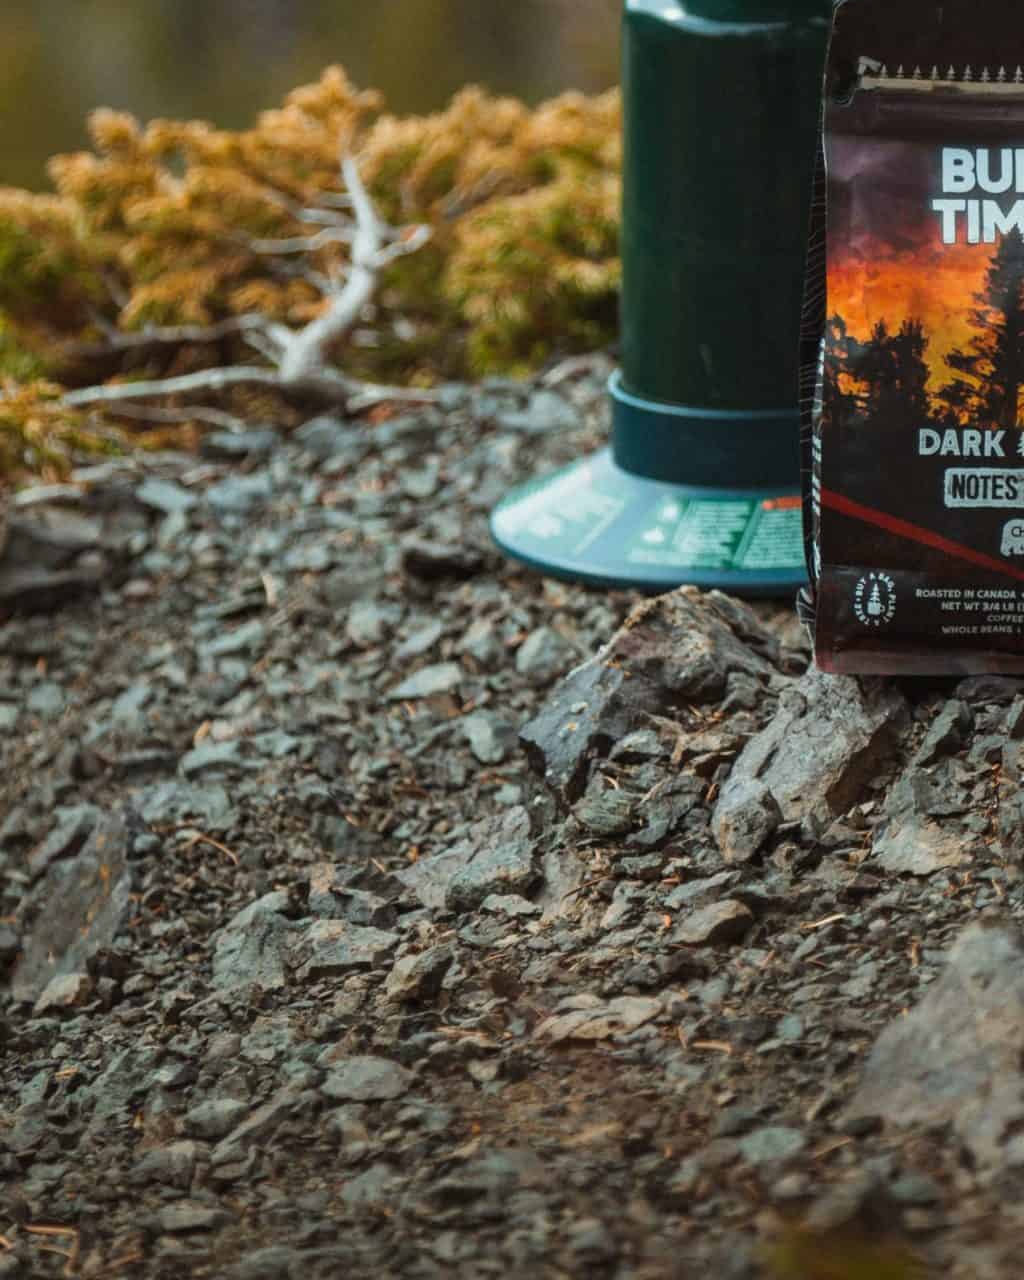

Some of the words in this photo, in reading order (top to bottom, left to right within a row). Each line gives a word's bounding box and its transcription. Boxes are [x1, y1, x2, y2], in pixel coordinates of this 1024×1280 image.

[918, 428, 1007, 457] DARK
[951, 474, 1019, 500] NOTES
[915, 589, 961, 599] ROASTED
[964, 590, 975, 598] IN
[977, 590, 1017, 599] CANADA
[941, 601, 961, 611] NET
[963, 602, 980, 611] WT
[986, 614, 1024, 624] COFFEE
[941, 626, 979, 635] WHOLE
